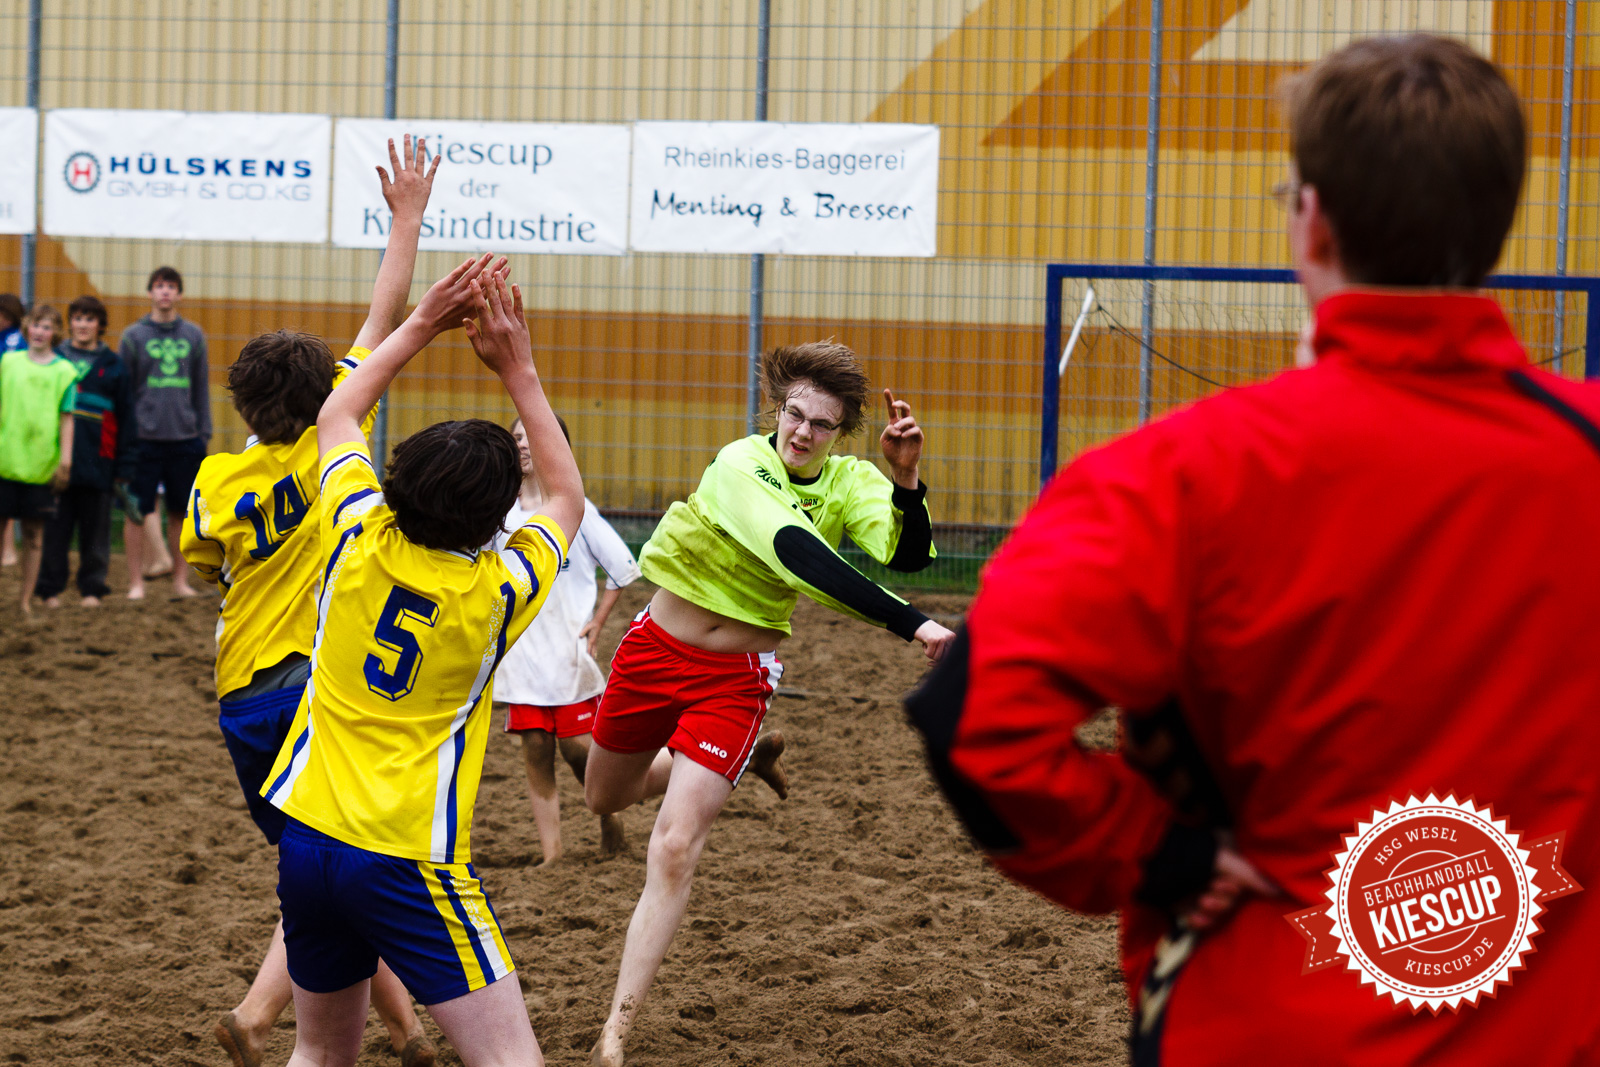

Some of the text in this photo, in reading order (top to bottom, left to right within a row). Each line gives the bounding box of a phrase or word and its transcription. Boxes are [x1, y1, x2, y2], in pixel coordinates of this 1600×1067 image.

[110, 153, 312, 178] HÜLSKENS
[664, 147, 905, 175] Rheinkies-Baggerei
[107, 180, 188, 198] GMBH
[459, 178, 499, 199] der
[651, 189, 914, 228] Menting & Bresser
[363, 207, 596, 243] Kisindustrie
[234, 471, 312, 561] 14
[363, 585, 440, 702] 5
[698, 741, 728, 759] JAKO
